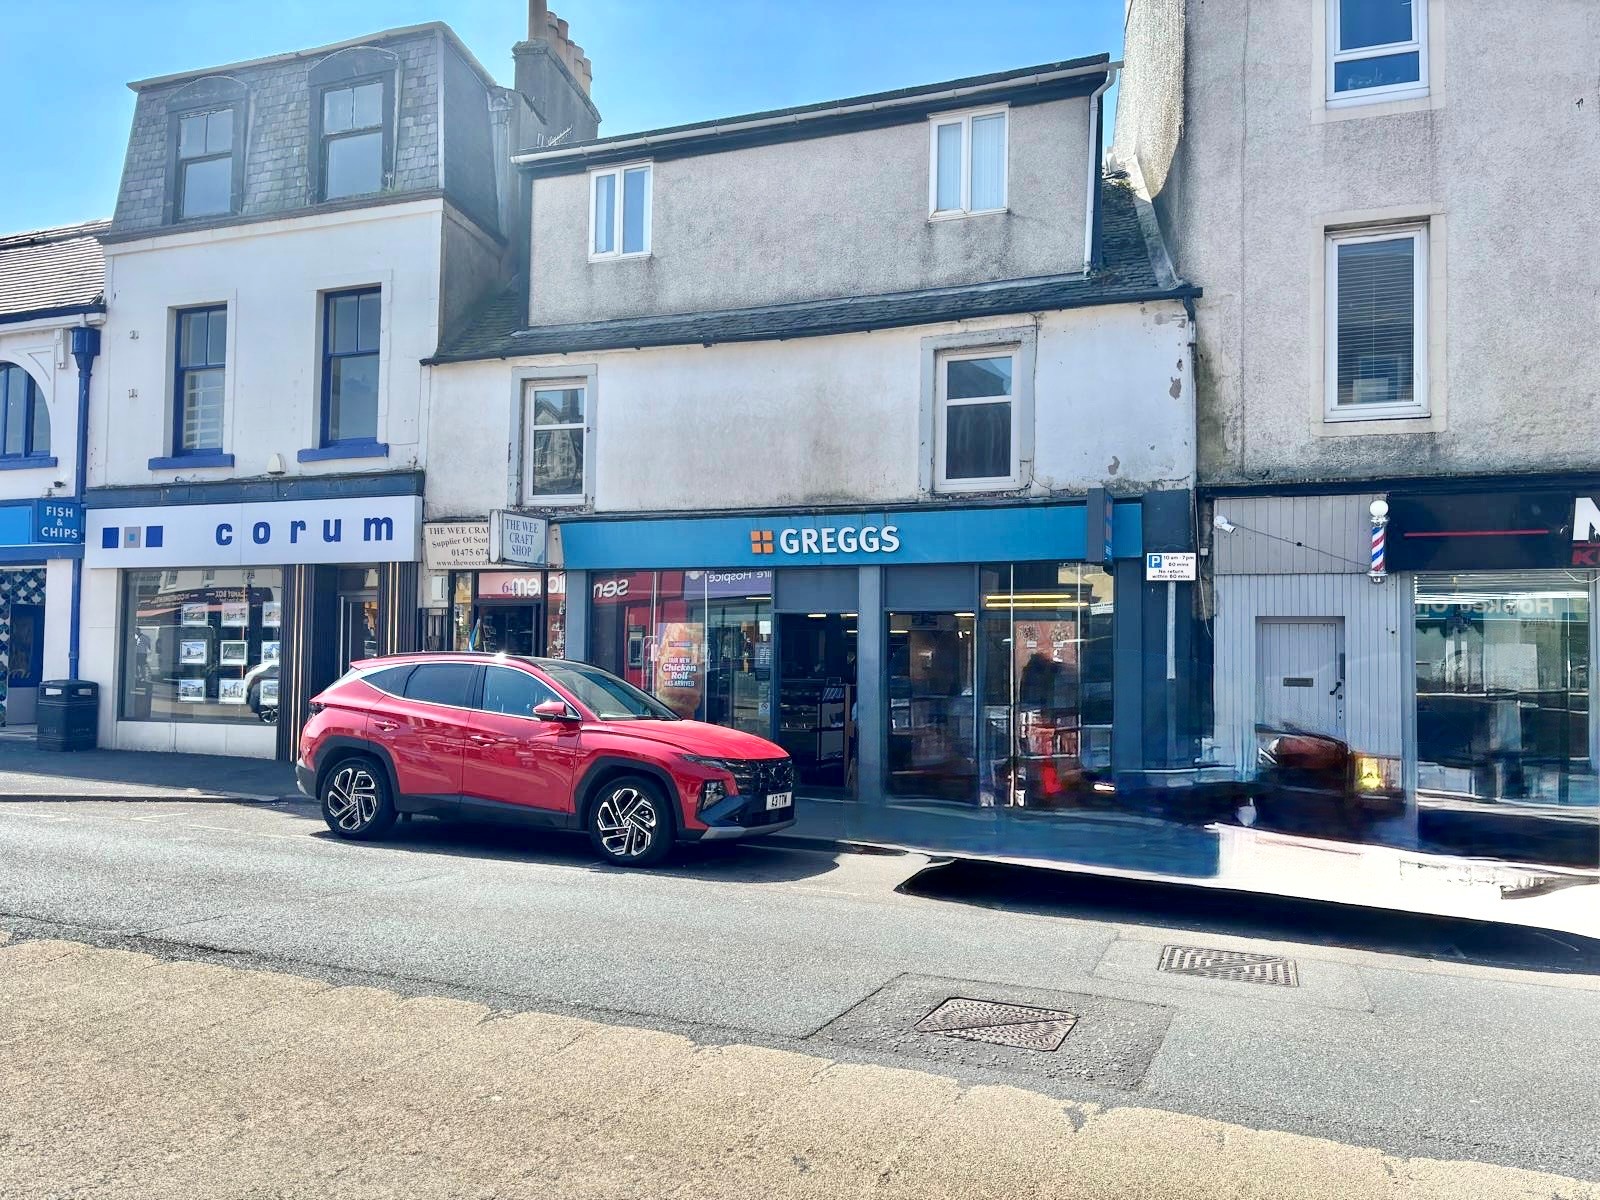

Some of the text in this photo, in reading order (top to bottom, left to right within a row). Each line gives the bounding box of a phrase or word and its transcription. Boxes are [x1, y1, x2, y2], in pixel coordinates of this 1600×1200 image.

[46, 506, 73, 518] FISH
[56, 518, 63, 526] &
[505, 519, 539, 534] THE WEE
[41, 527, 78, 539] CHIPS
[215, 516, 393, 546] corum
[428, 527, 446, 535] THE
[447, 527, 467, 535] WEE
[431, 538, 461, 549] Supplier
[509, 533, 535, 545] CRAFT
[779, 525, 901, 554] GREGGS
[451, 548, 474, 557] 01475
[511, 545, 532, 557] SHOP
[662, 663, 697, 672] Chicken
[671, 671, 689, 680] Roll
